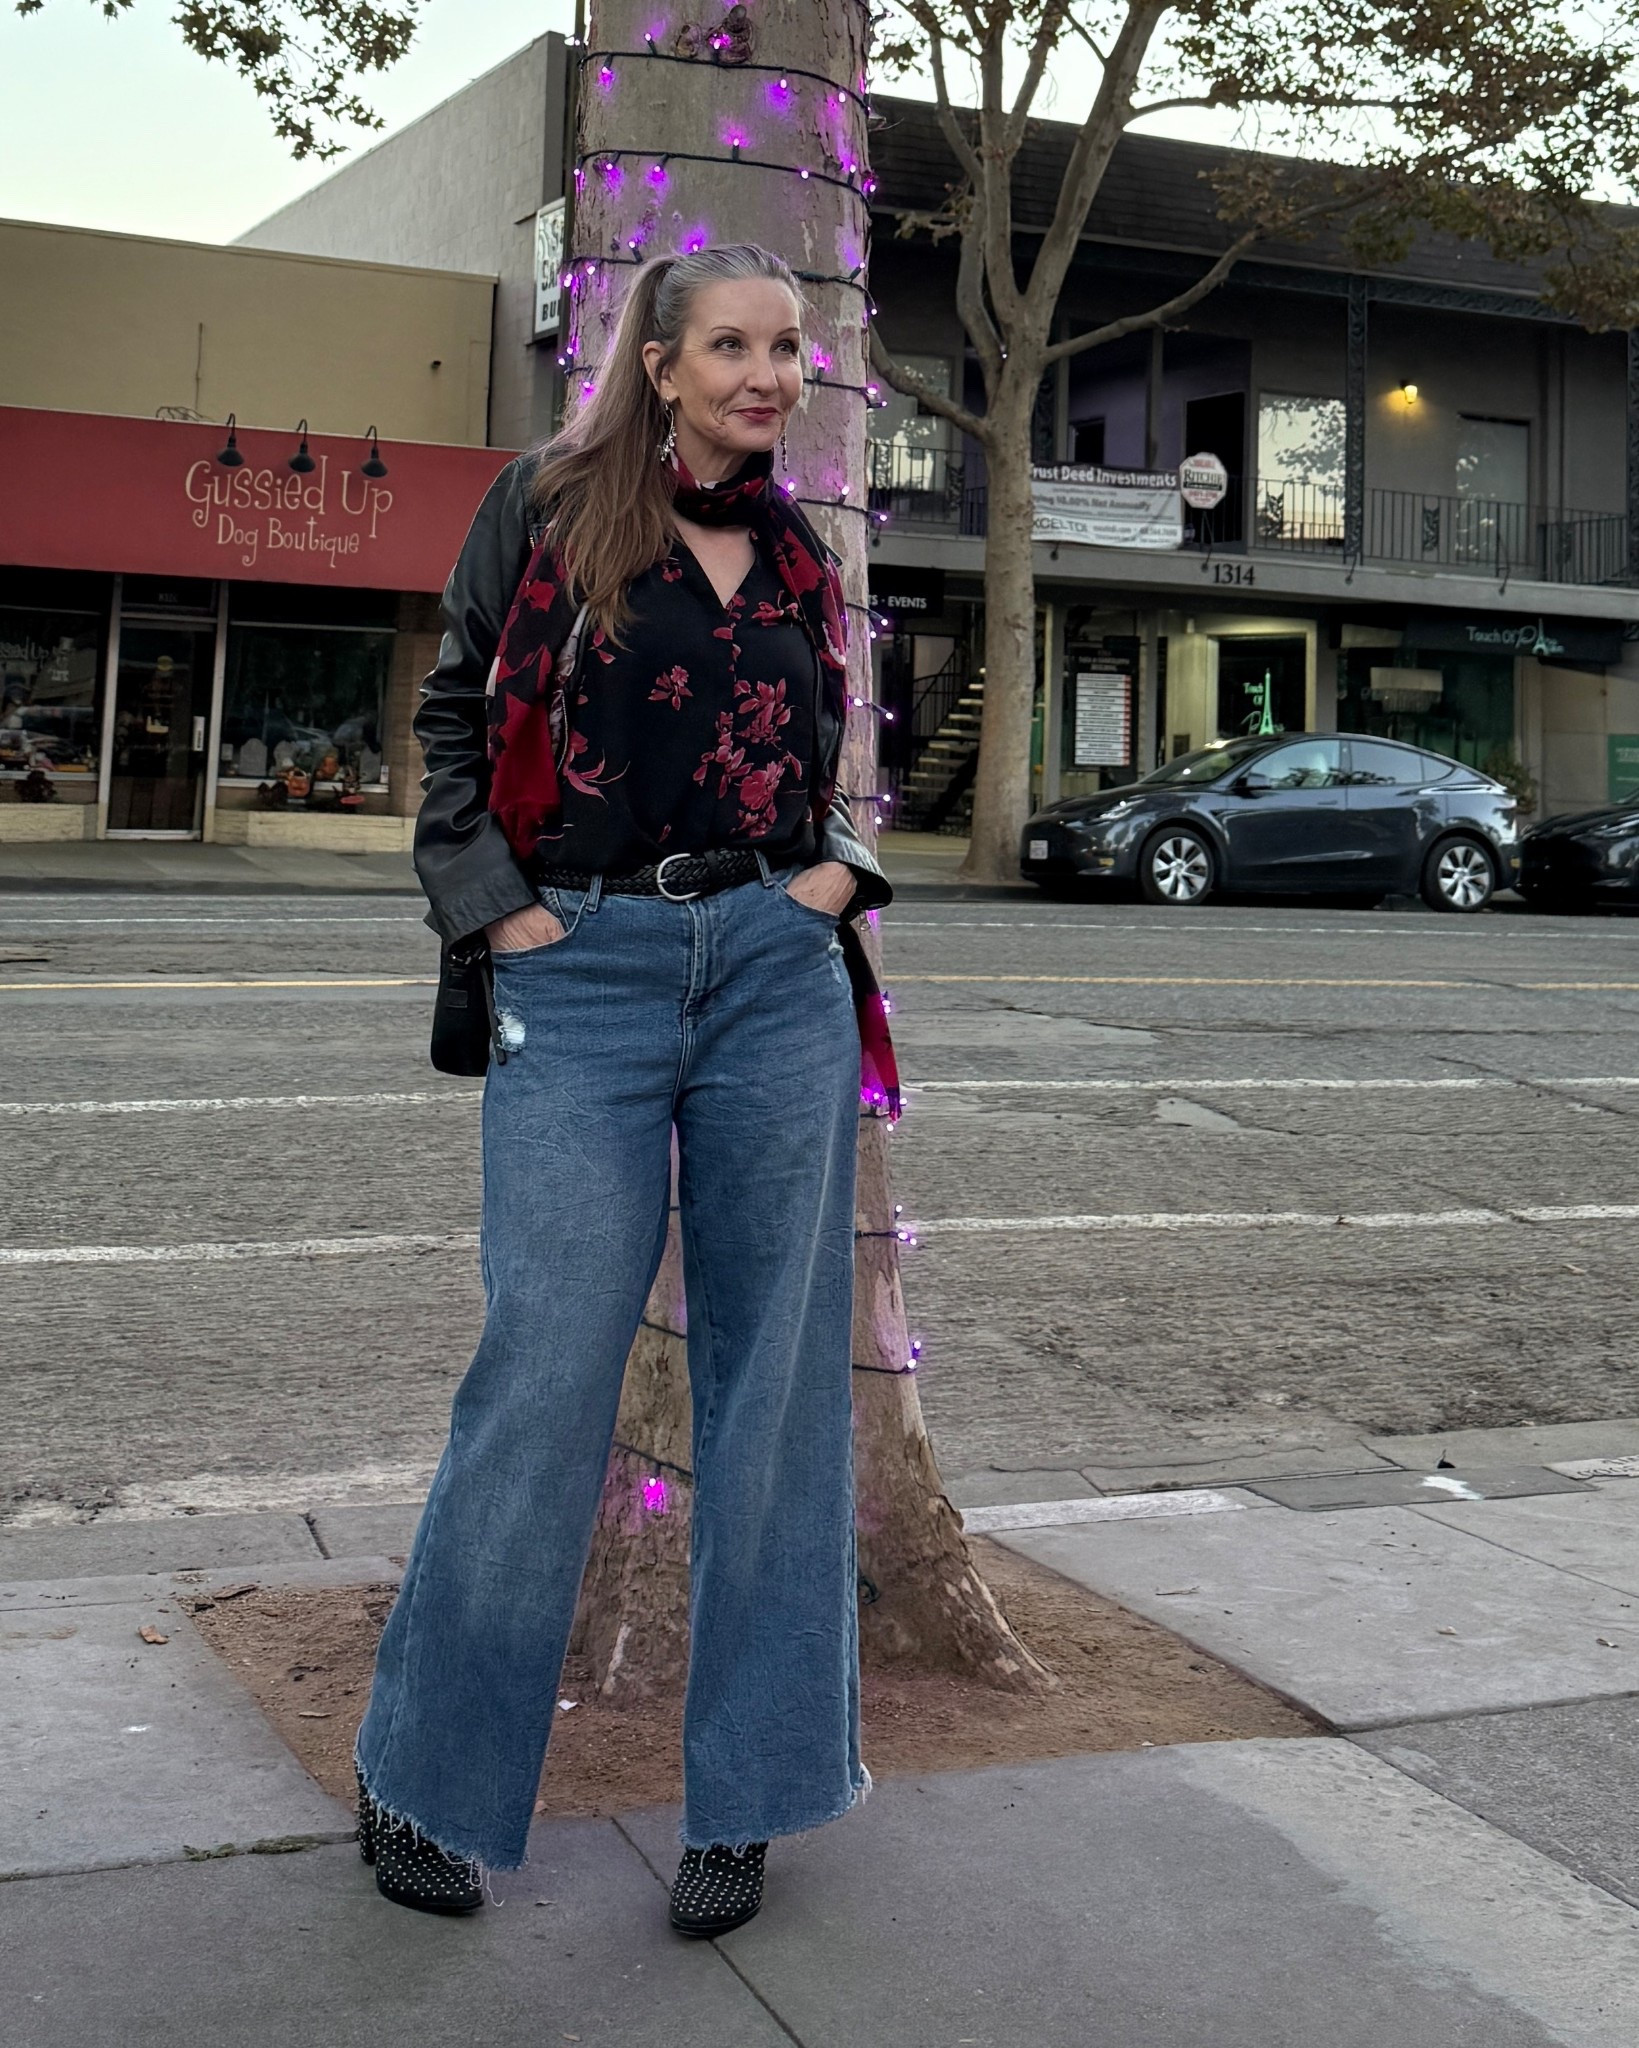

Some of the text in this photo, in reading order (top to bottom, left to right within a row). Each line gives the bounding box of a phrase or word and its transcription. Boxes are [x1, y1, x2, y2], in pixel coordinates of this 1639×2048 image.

[1061, 465, 1095, 482] Deed
[1096, 468, 1177, 487] Investments
[185, 455, 393, 538] Gussied Up
[217, 513, 360, 568] Dog Boutique
[1213, 563, 1256, 586] 1314
[887, 596, 927, 609] EVENTS
[1465, 626, 1501, 643] Touch
